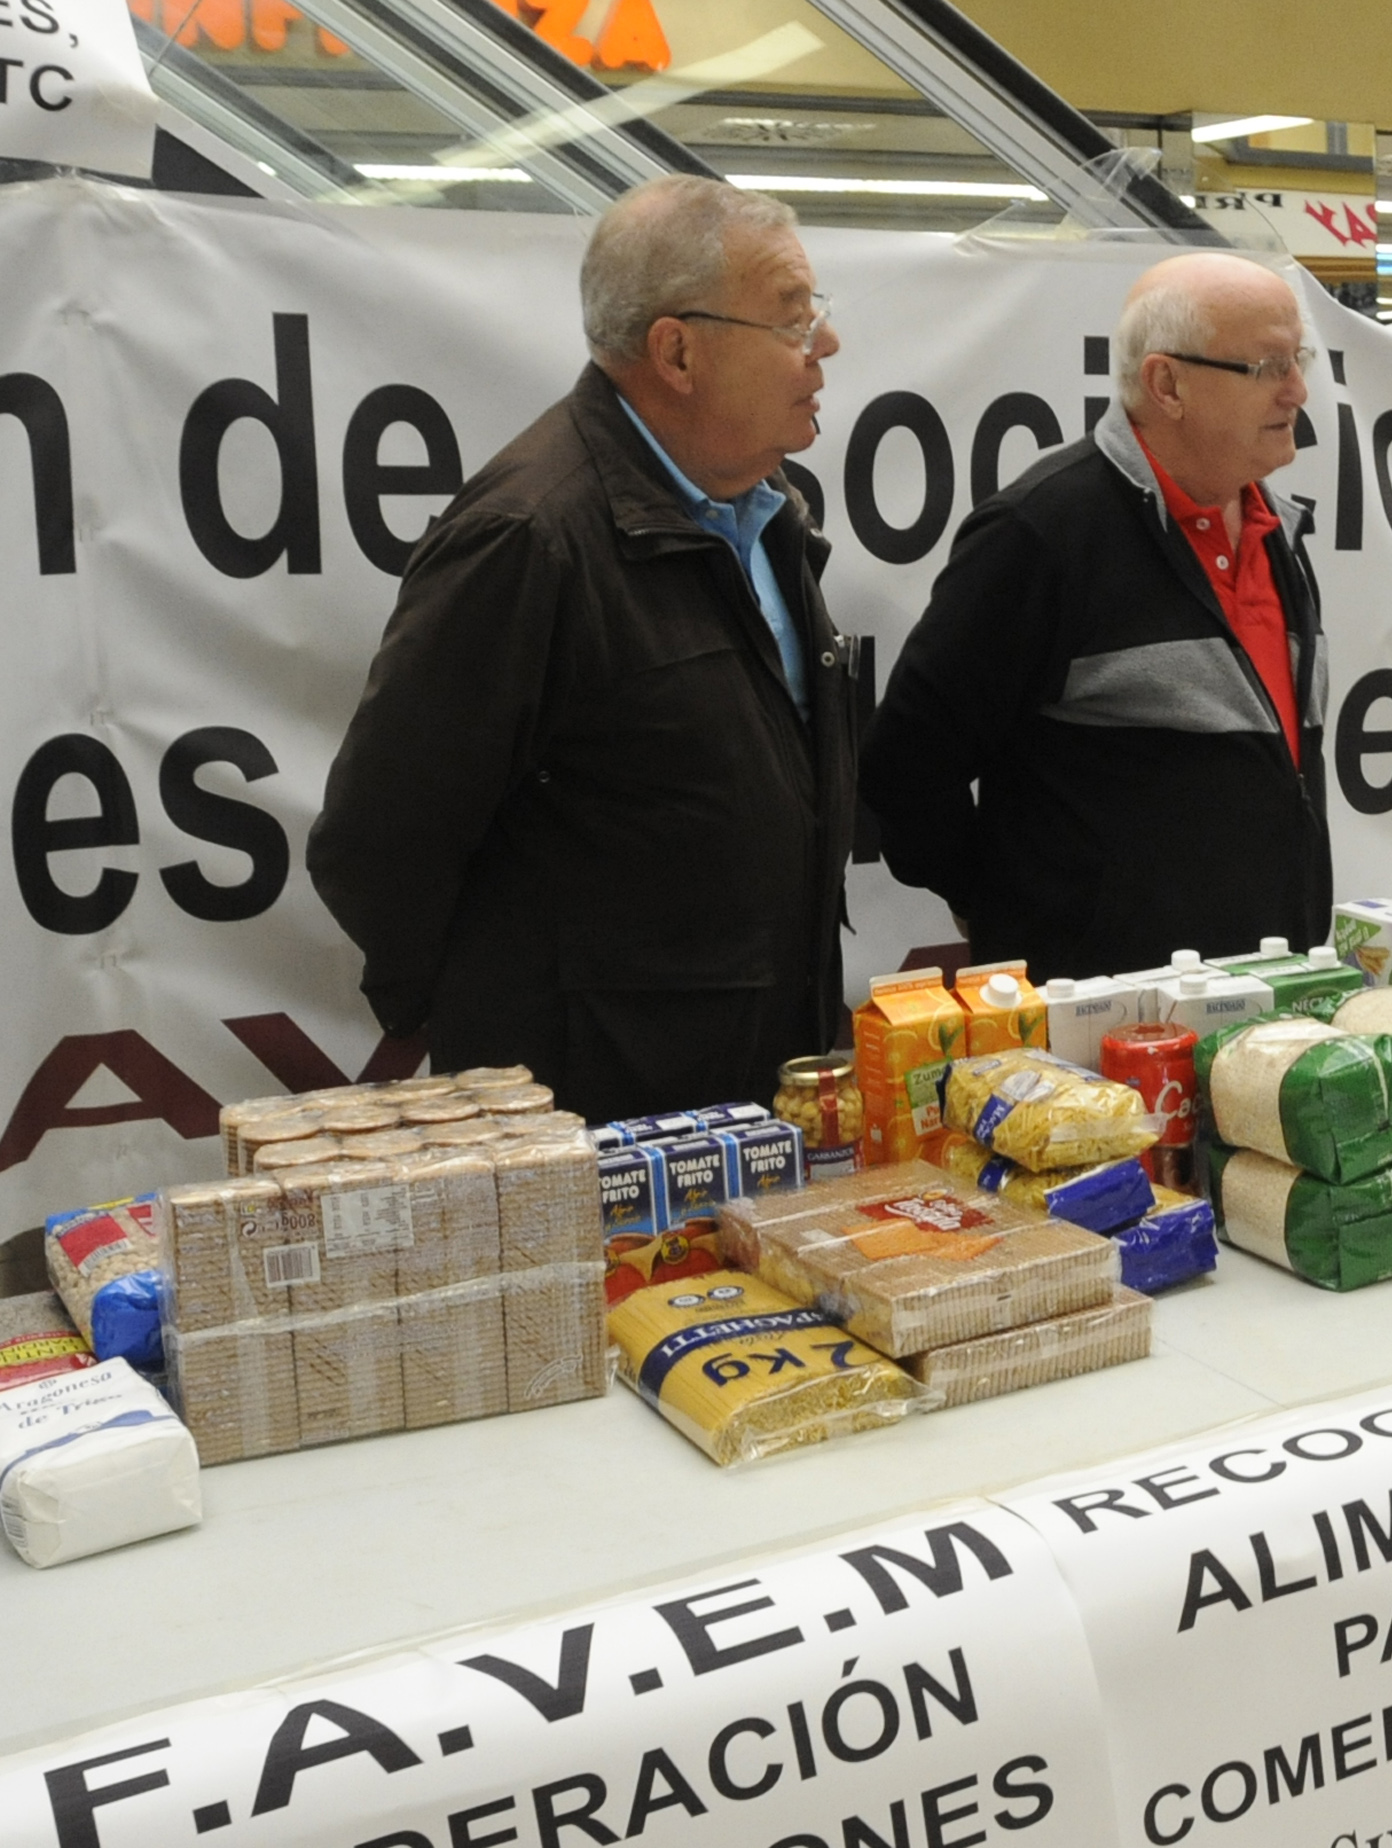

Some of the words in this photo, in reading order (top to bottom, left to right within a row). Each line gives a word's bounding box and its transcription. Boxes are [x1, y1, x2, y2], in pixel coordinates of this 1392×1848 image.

[179, 312, 465, 580] de
[743, 1140, 793, 1160] TOMATE
[668, 1153, 721, 1176] TOMATE
[750, 1155, 786, 1175] FRITO
[677, 1170, 714, 1189] FRITO
[602, 1185, 641, 1204] FRITO
[351, 1645, 980, 1848] ERACIÓN
